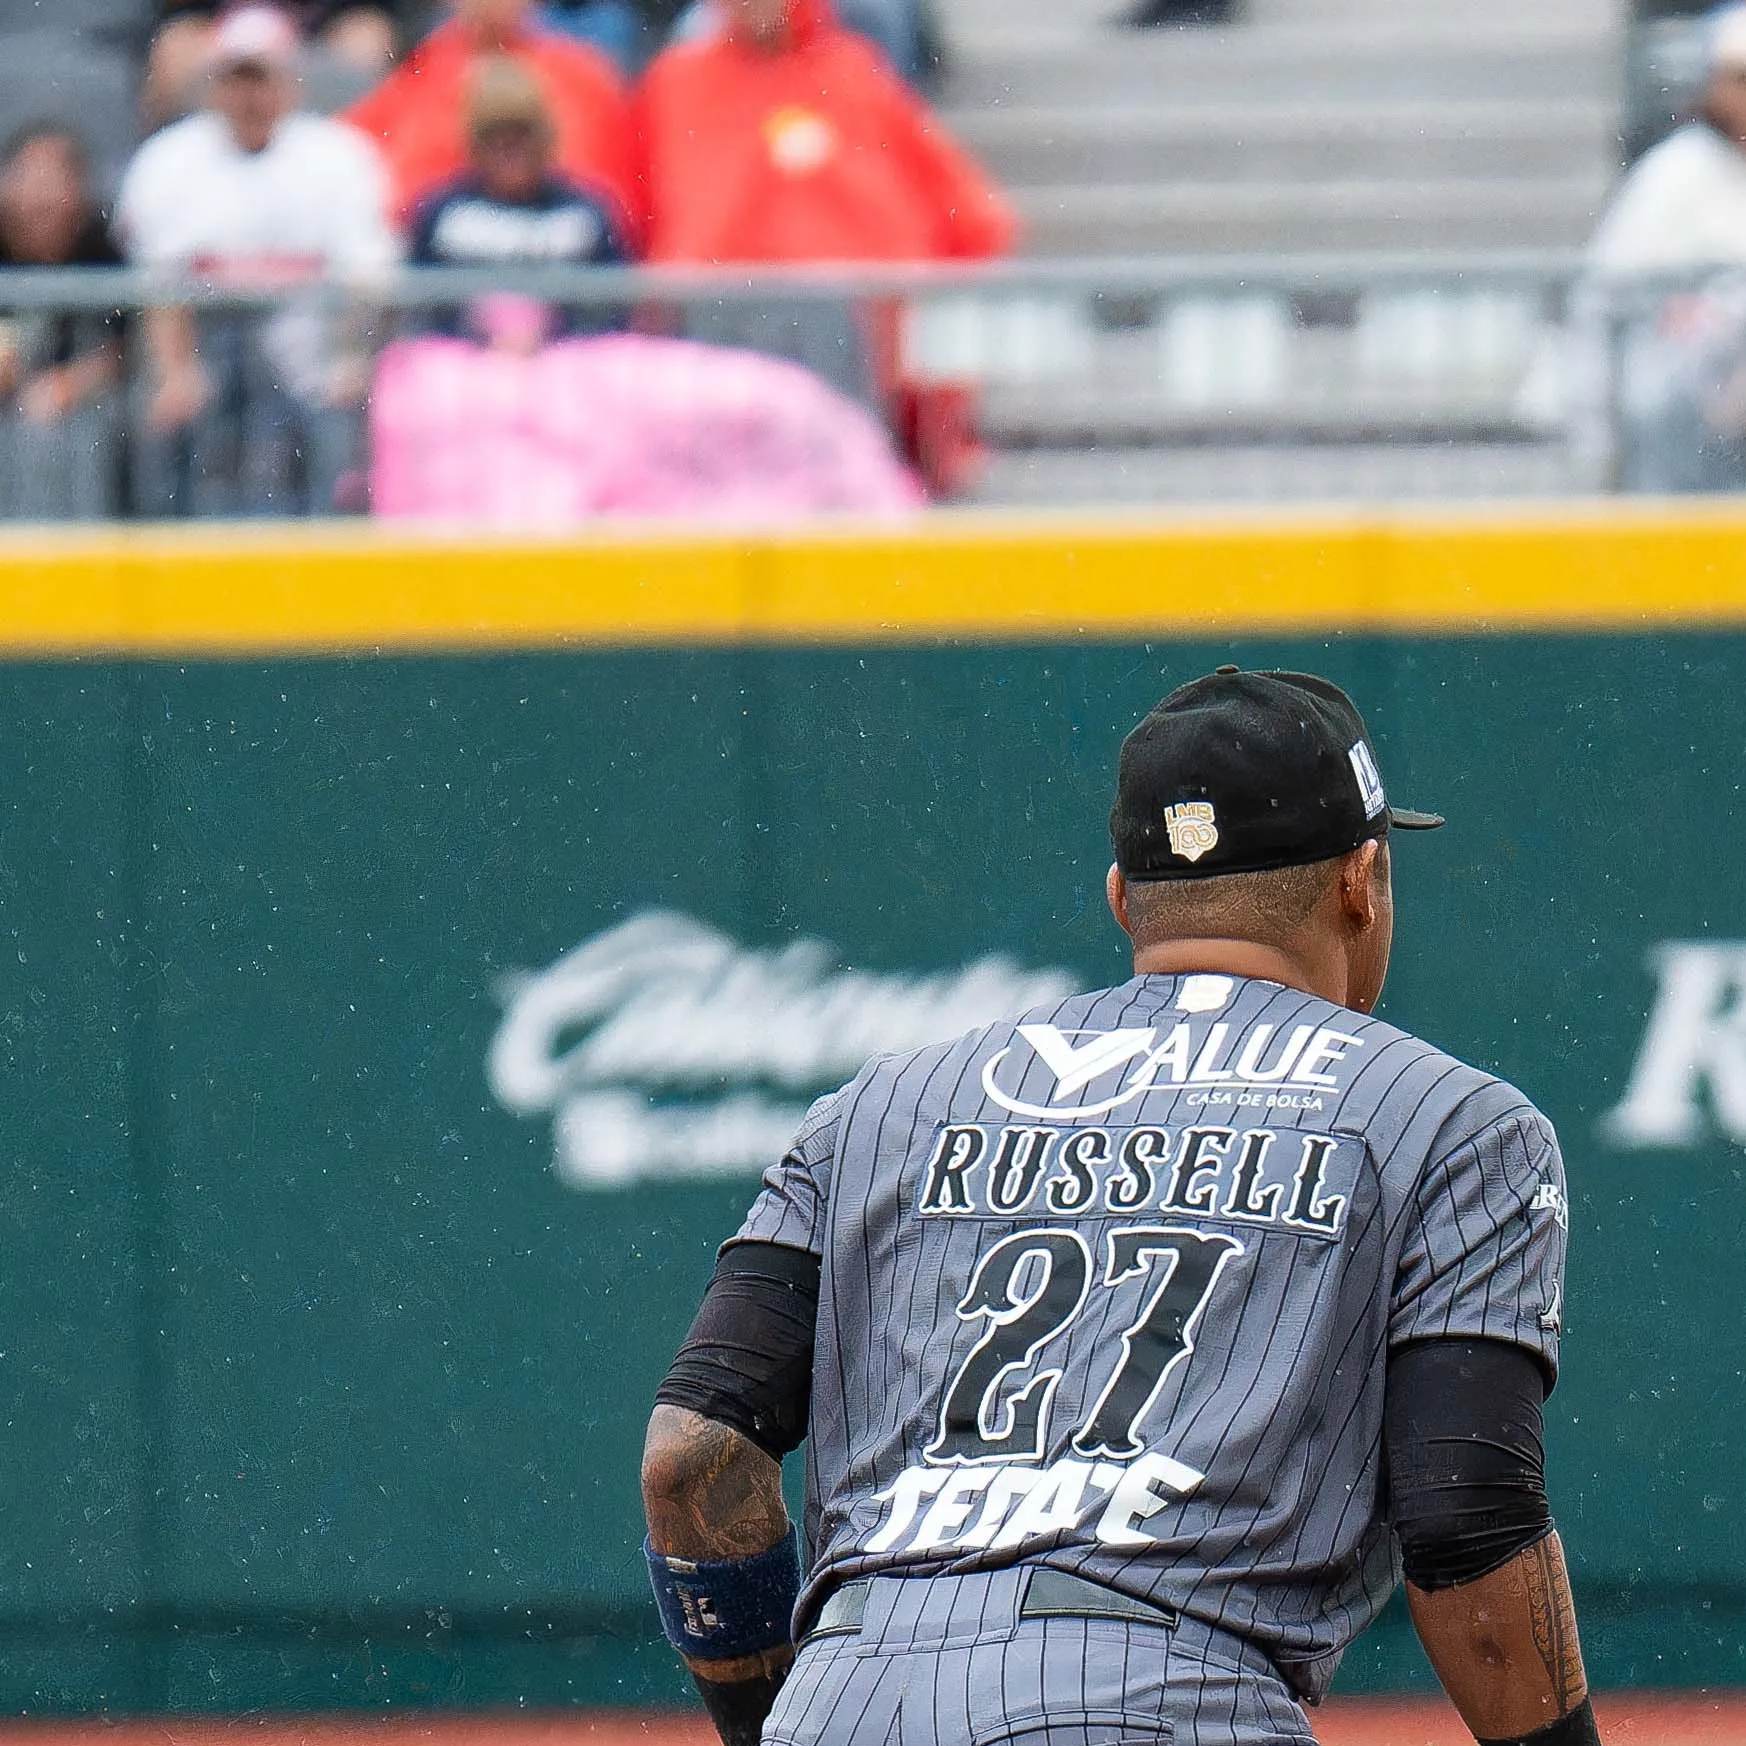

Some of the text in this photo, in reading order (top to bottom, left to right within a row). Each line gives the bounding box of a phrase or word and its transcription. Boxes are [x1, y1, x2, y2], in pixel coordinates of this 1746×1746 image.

[1016, 1023, 1365, 1102] VALUE
[1186, 1093, 1323, 1112] CASA DE BOLSA
[919, 1123, 1346, 1235] RUSSELL
[923, 1226, 1244, 1465] 27
